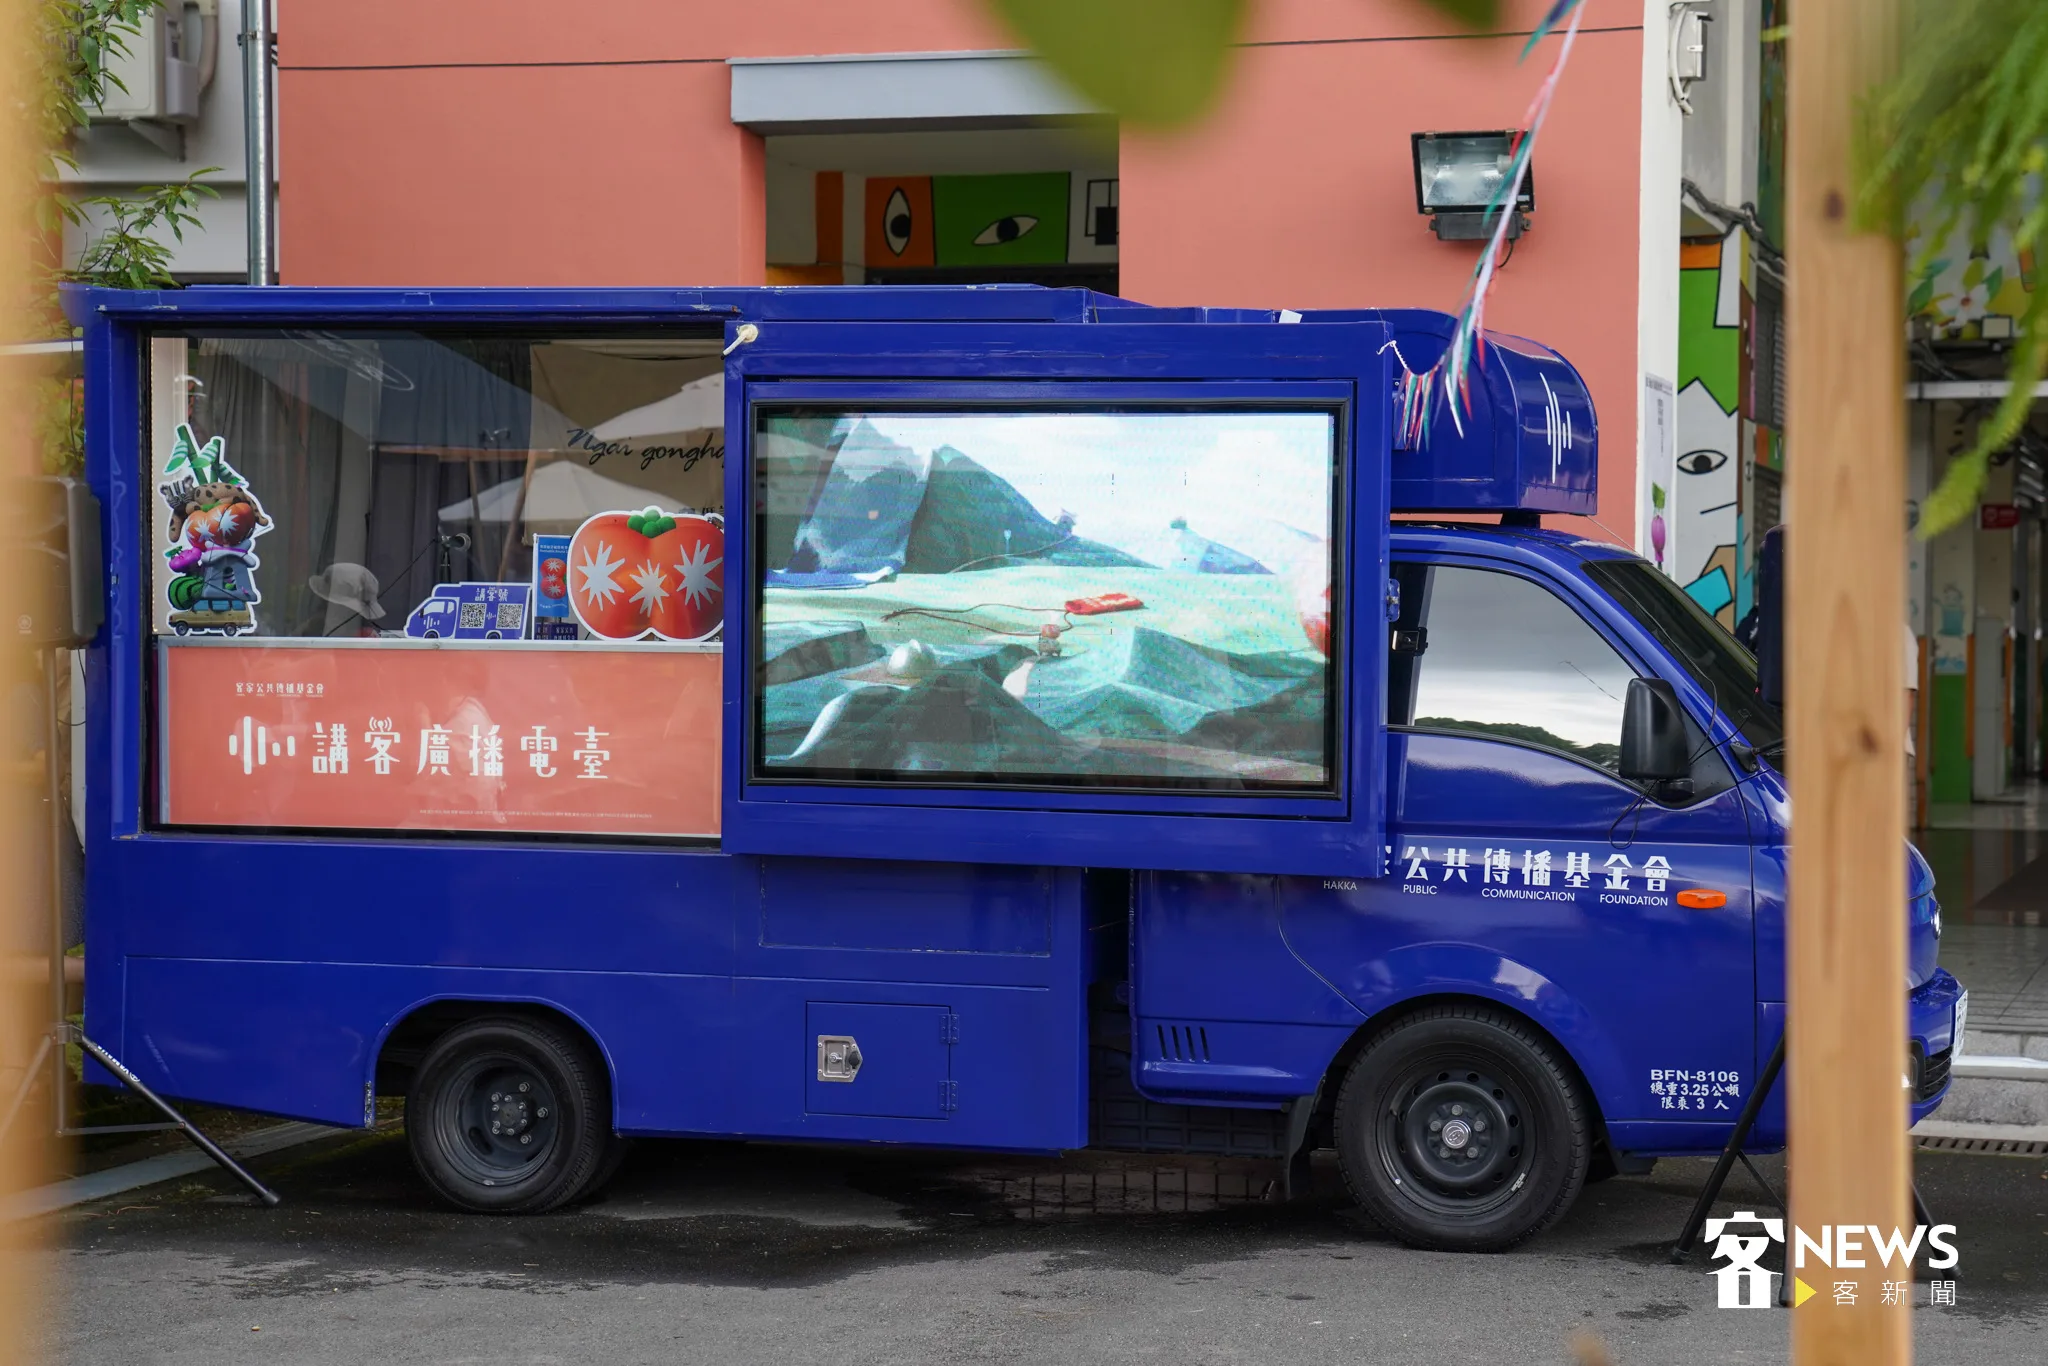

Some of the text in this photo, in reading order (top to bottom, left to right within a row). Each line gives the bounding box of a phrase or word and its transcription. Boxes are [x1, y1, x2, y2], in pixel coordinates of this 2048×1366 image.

[567, 428, 724, 471] Ngai gongha
[312, 716, 610, 779] 講客廣播電臺
[1384, 846, 1673, 892] 公共傳播基金會
[1323, 880, 1669, 907] HAKKA PUBLIC COMMUNICATION FOUNDATION
[1650, 1069, 1739, 1082] BFN-8106
